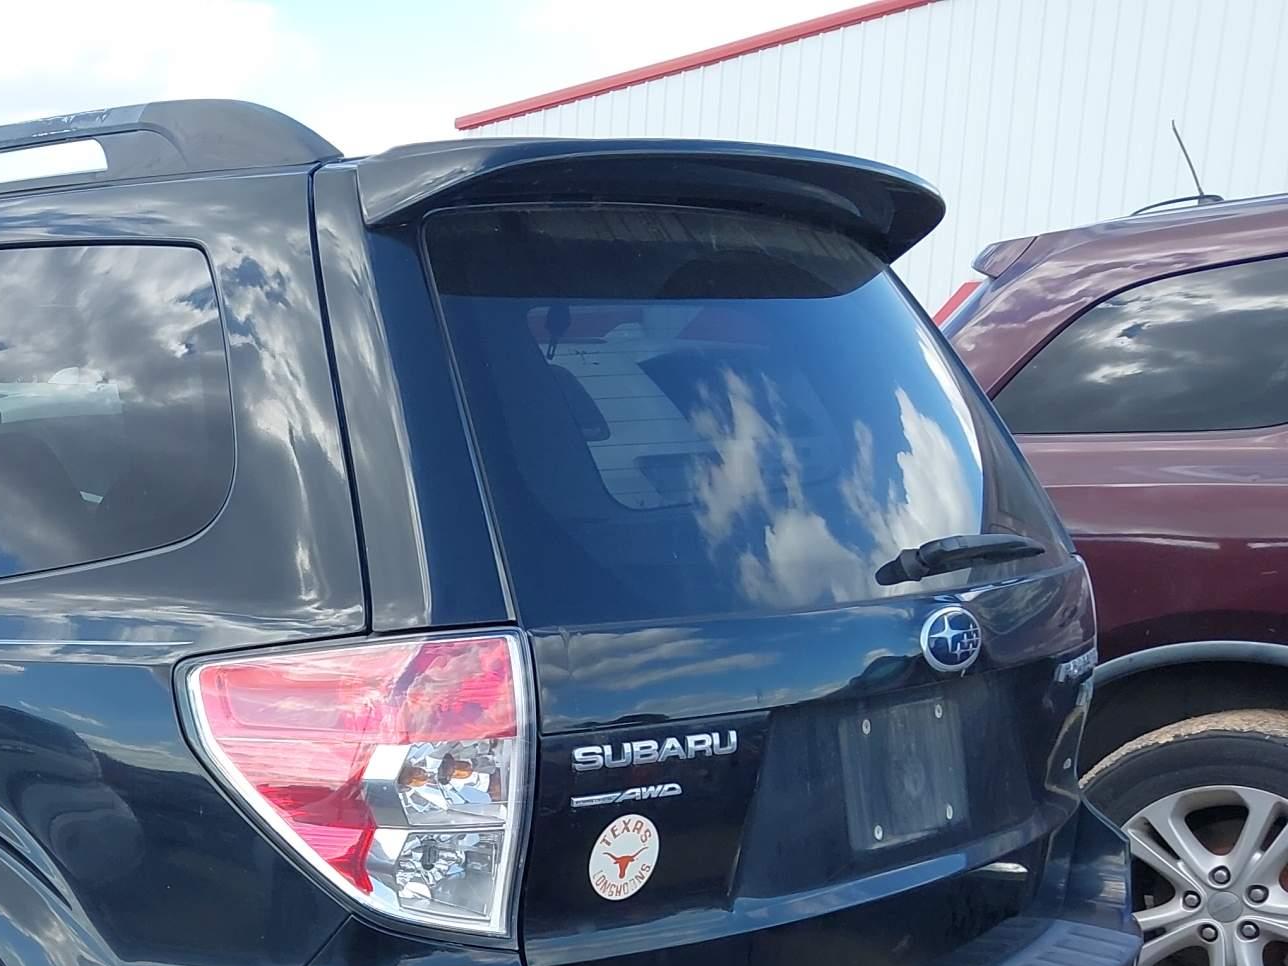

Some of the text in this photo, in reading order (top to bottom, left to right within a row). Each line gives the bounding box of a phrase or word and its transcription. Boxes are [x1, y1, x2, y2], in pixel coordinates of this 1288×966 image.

[572, 730, 737, 772] SUBARU
[615, 783, 682, 802] AWD
[599, 818, 652, 847] TEXAS
